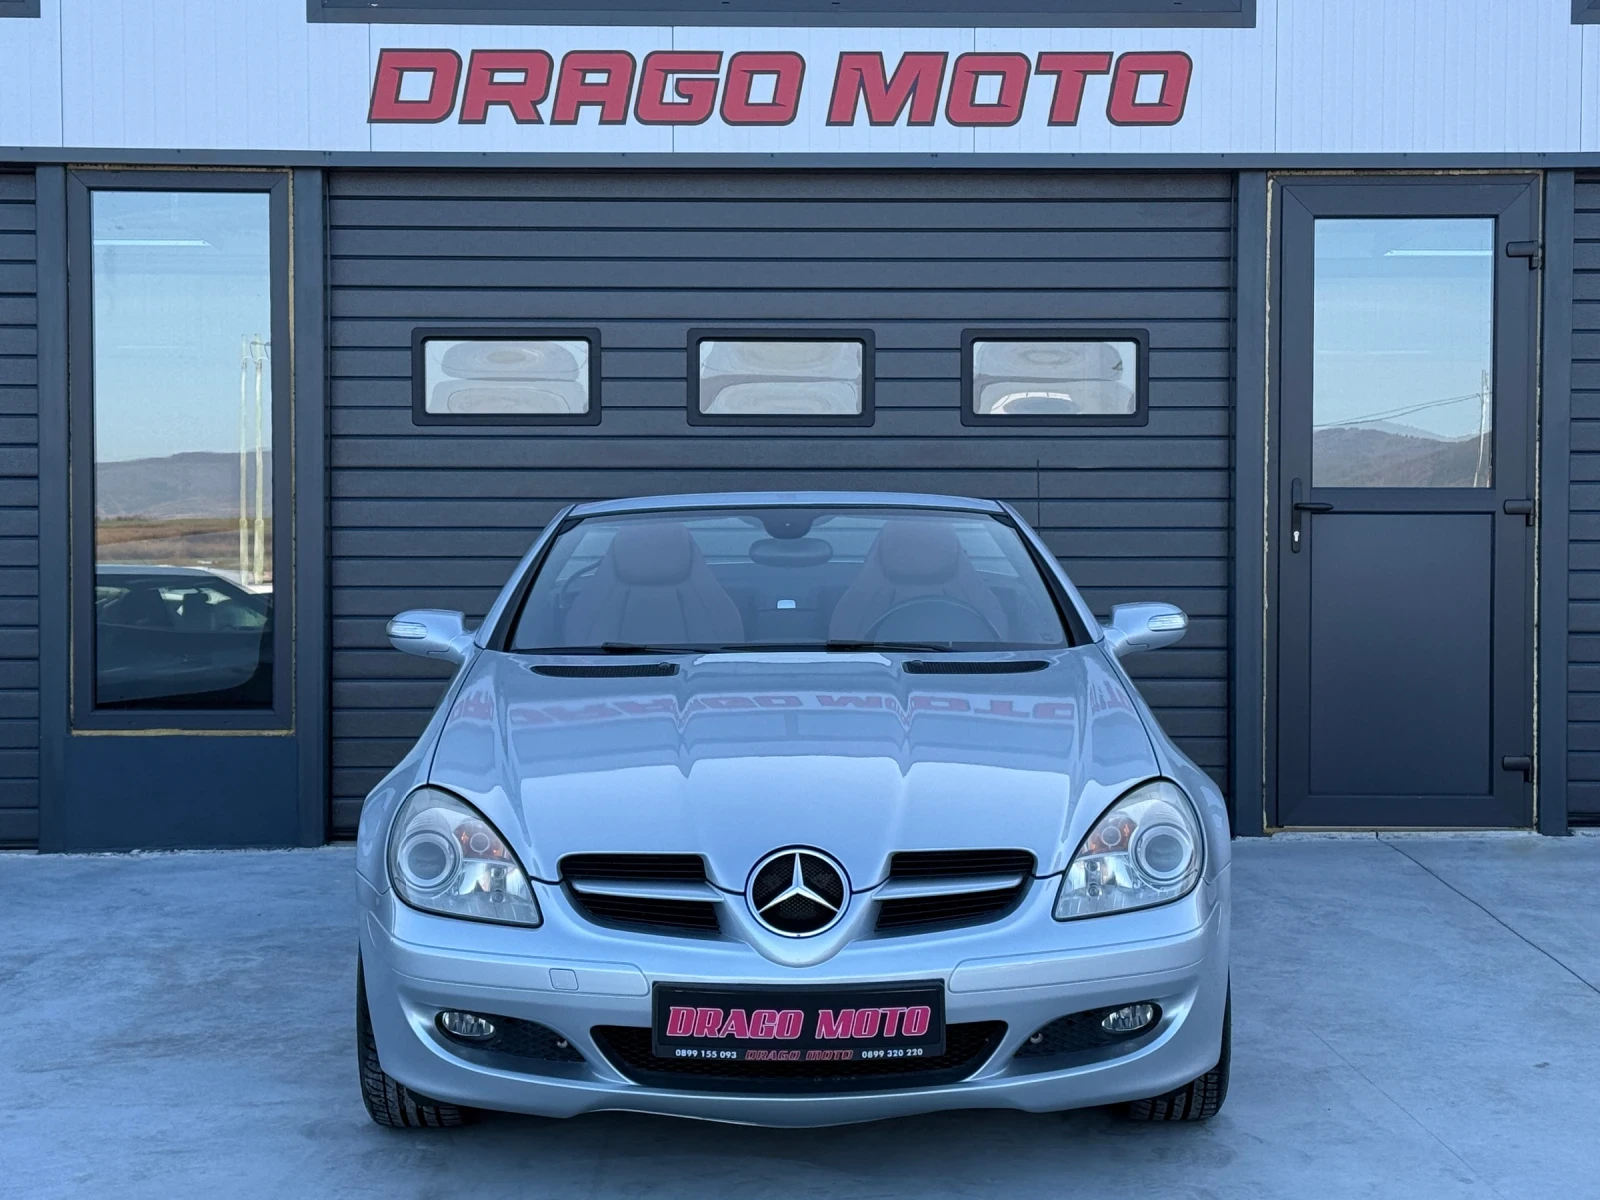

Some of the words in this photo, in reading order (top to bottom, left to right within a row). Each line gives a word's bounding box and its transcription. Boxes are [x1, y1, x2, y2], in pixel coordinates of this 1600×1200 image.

[367, 48, 806, 126] DRAGO
[826, 51, 1194, 127] MOTO
[666, 1006, 805, 1039] DRAGO
[815, 1006, 931, 1039] MOTO
[675, 1049, 698, 1058] 0899
[701, 1050, 717, 1058] 155
[720, 1051, 737, 1059] 093
[744, 1050, 801, 1060] DRAGO
[805, 1050, 854, 1060] MOTO
[861, 1050, 885, 1059] 0899
[887, 1049, 904, 1058] 320
[906, 1048, 923, 1057] 220
